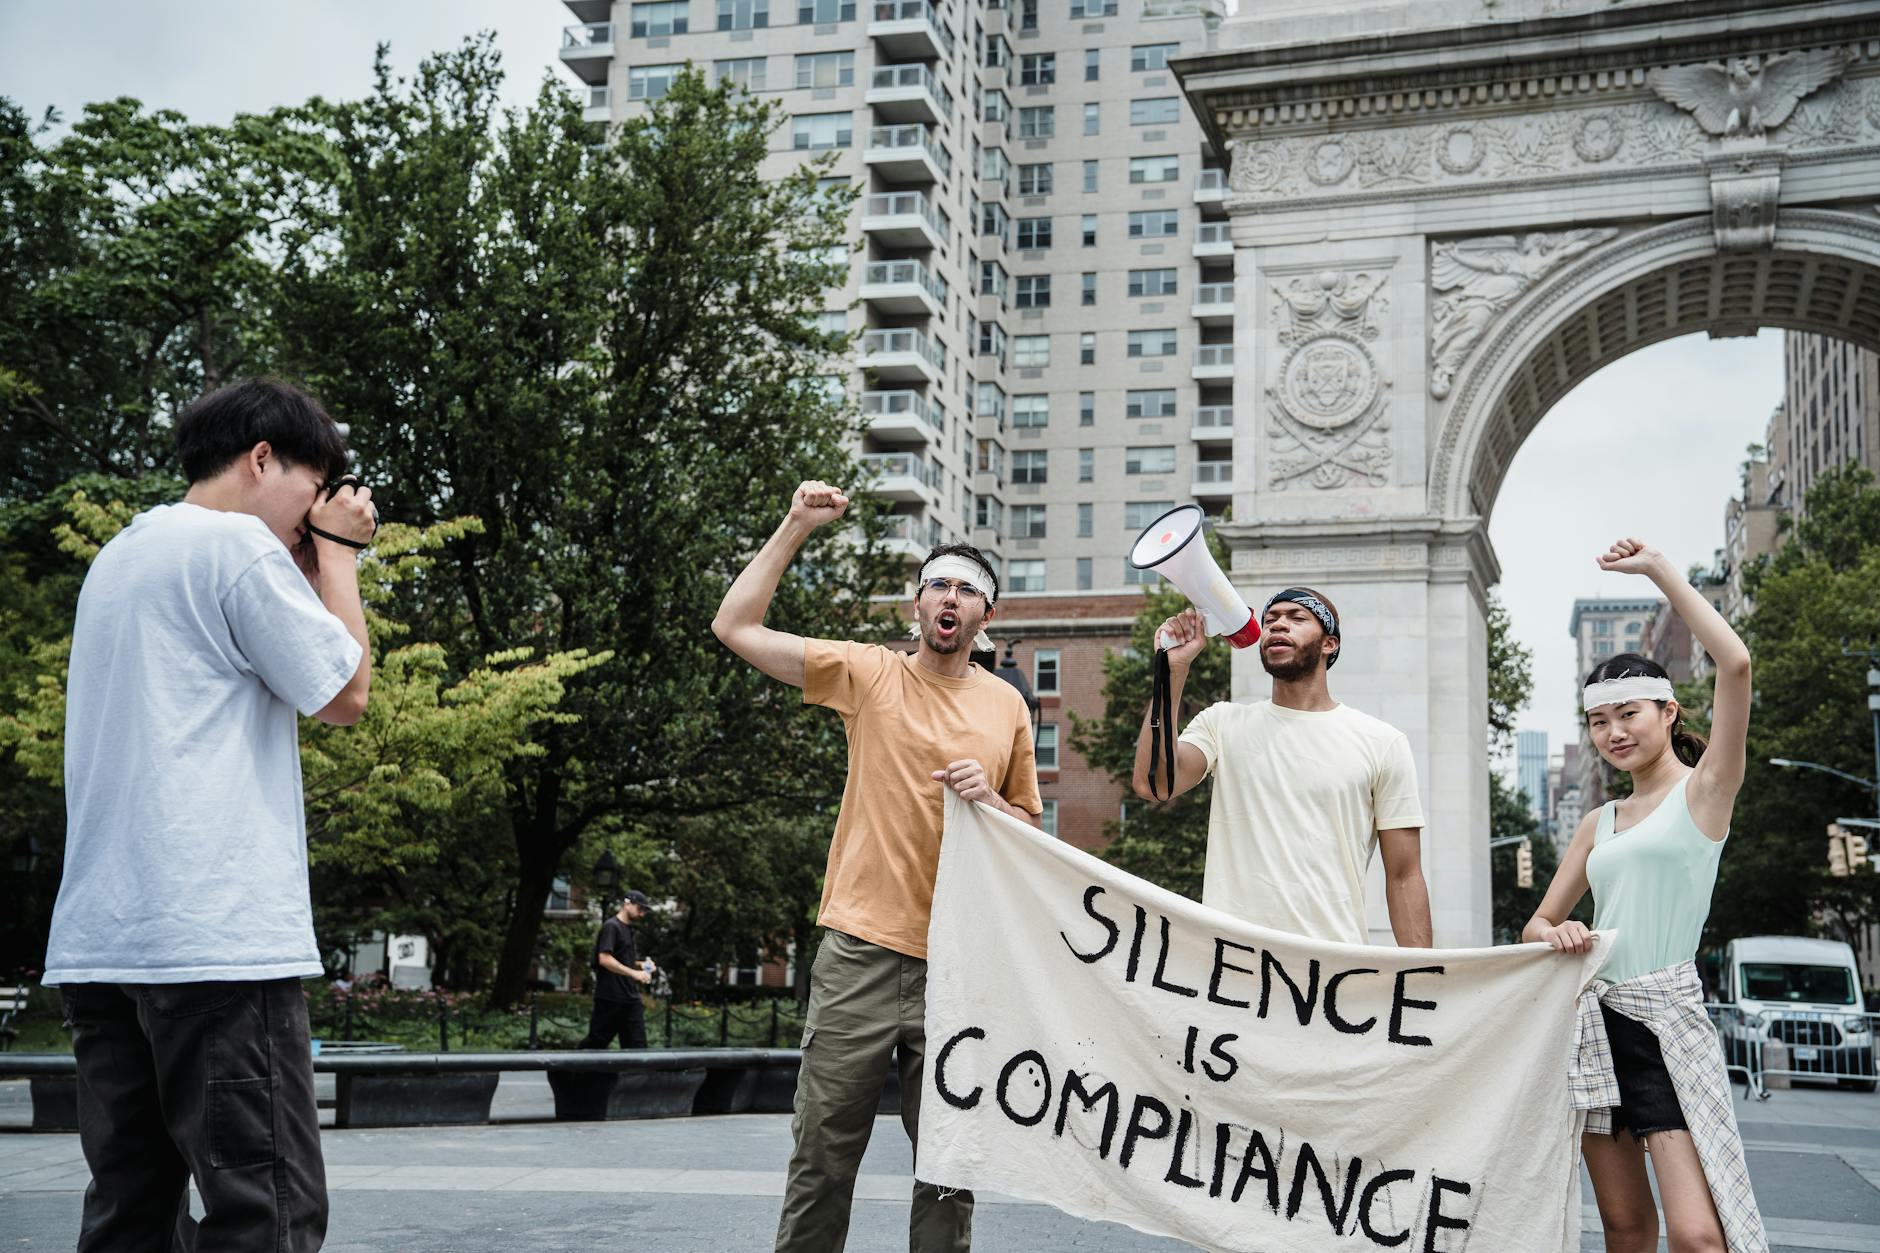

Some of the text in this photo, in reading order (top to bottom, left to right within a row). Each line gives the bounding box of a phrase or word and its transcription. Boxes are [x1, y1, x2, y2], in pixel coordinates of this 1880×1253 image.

[1060, 885, 1446, 1047] SILENCE
[1184, 1025, 1239, 1082] IS
[934, 1026, 1472, 1253] COMPLIANCE
